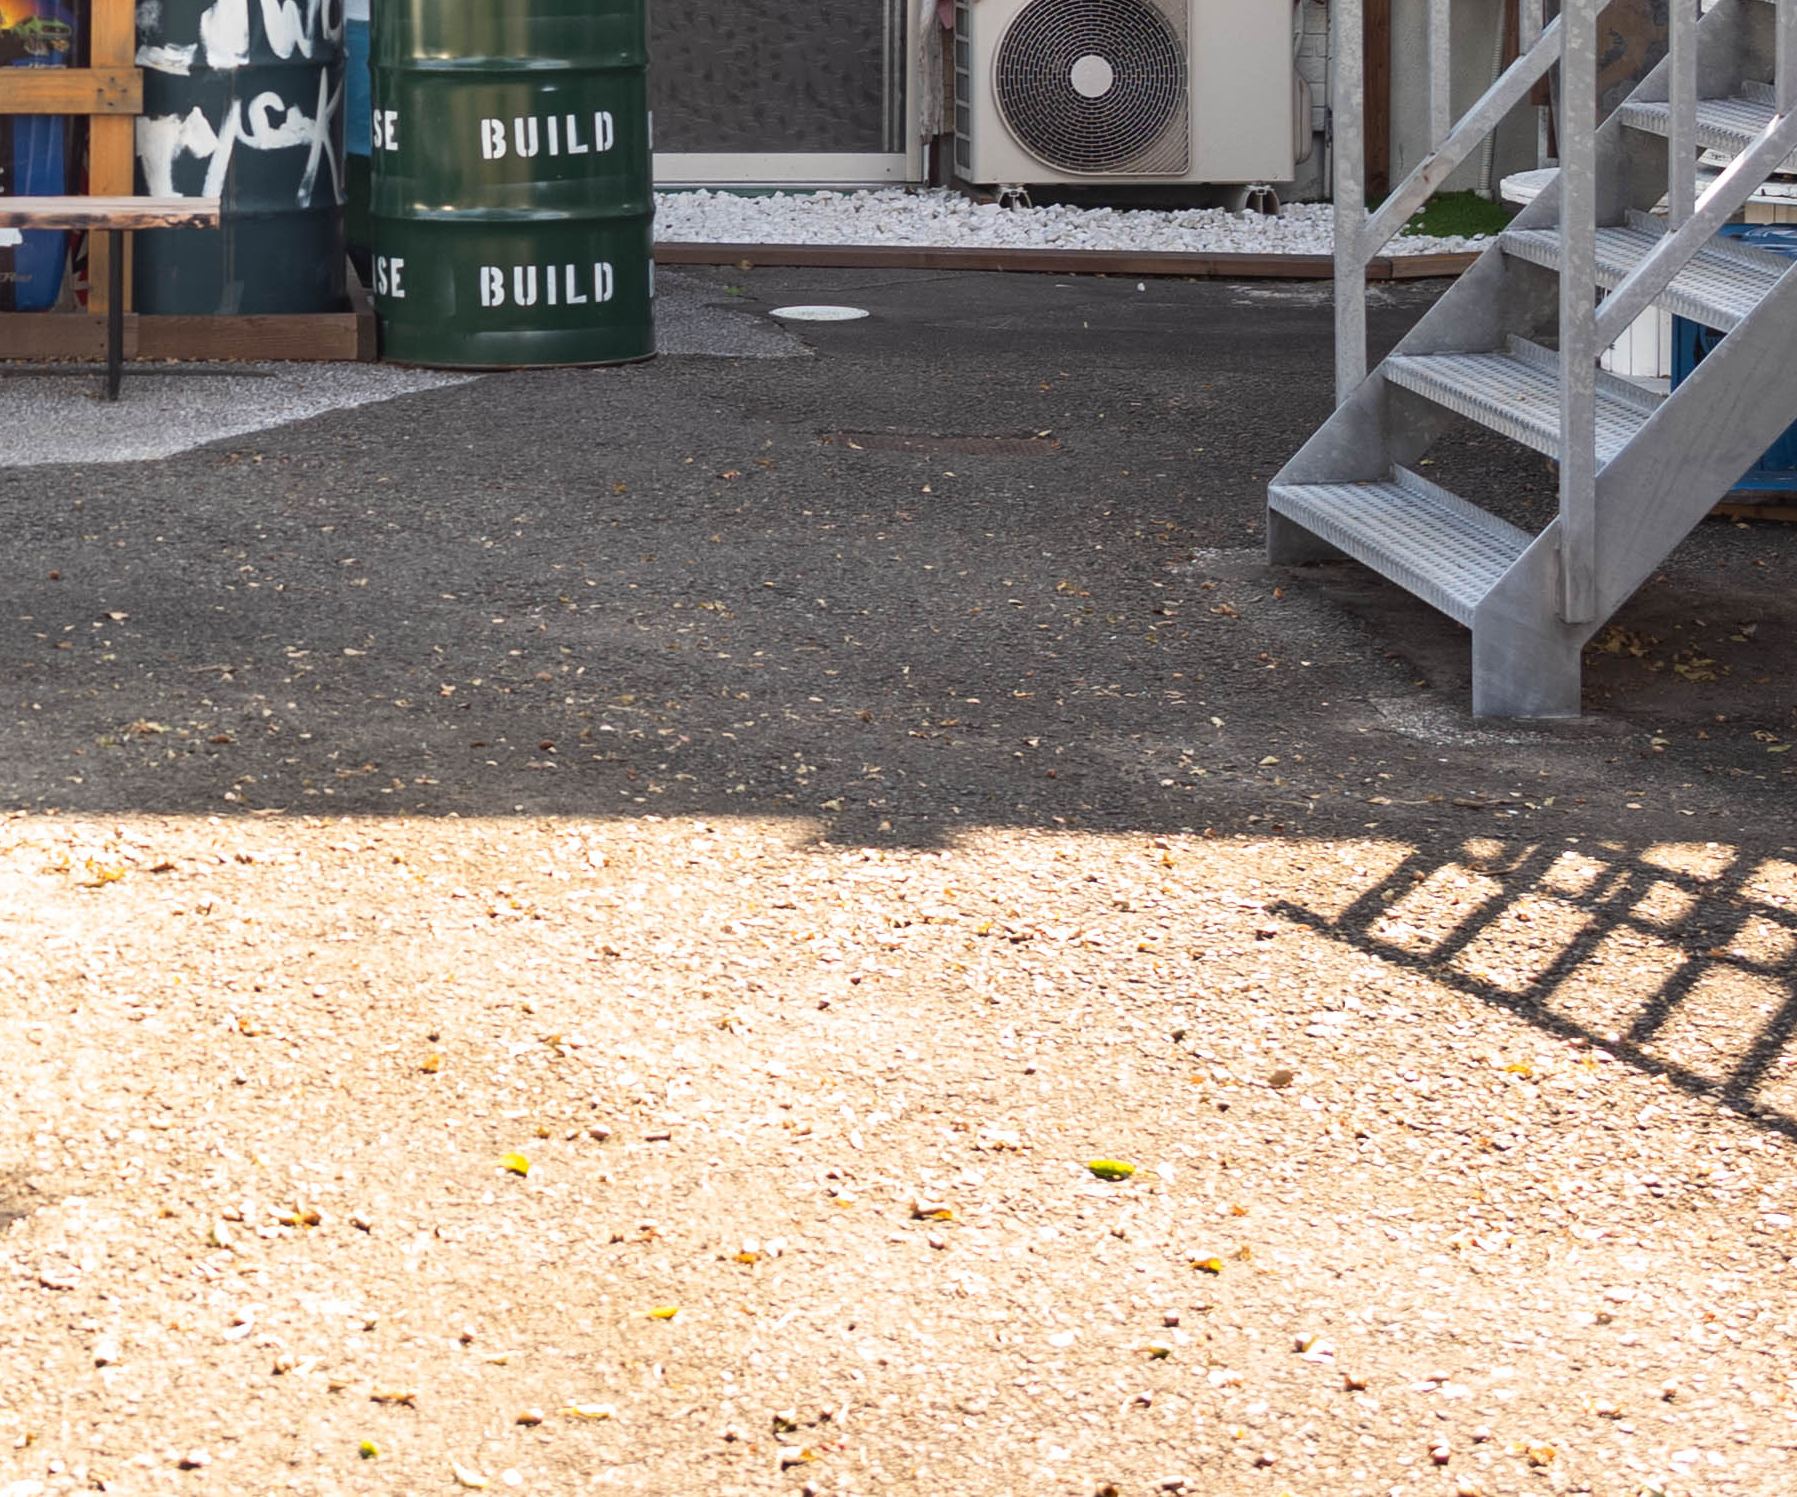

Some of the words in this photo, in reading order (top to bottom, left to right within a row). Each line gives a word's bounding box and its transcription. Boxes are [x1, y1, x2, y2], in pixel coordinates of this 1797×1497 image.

[481, 111, 615, 160] BUILD
[372, 255, 406, 298] SE
[479, 262, 615, 307] BUILD
